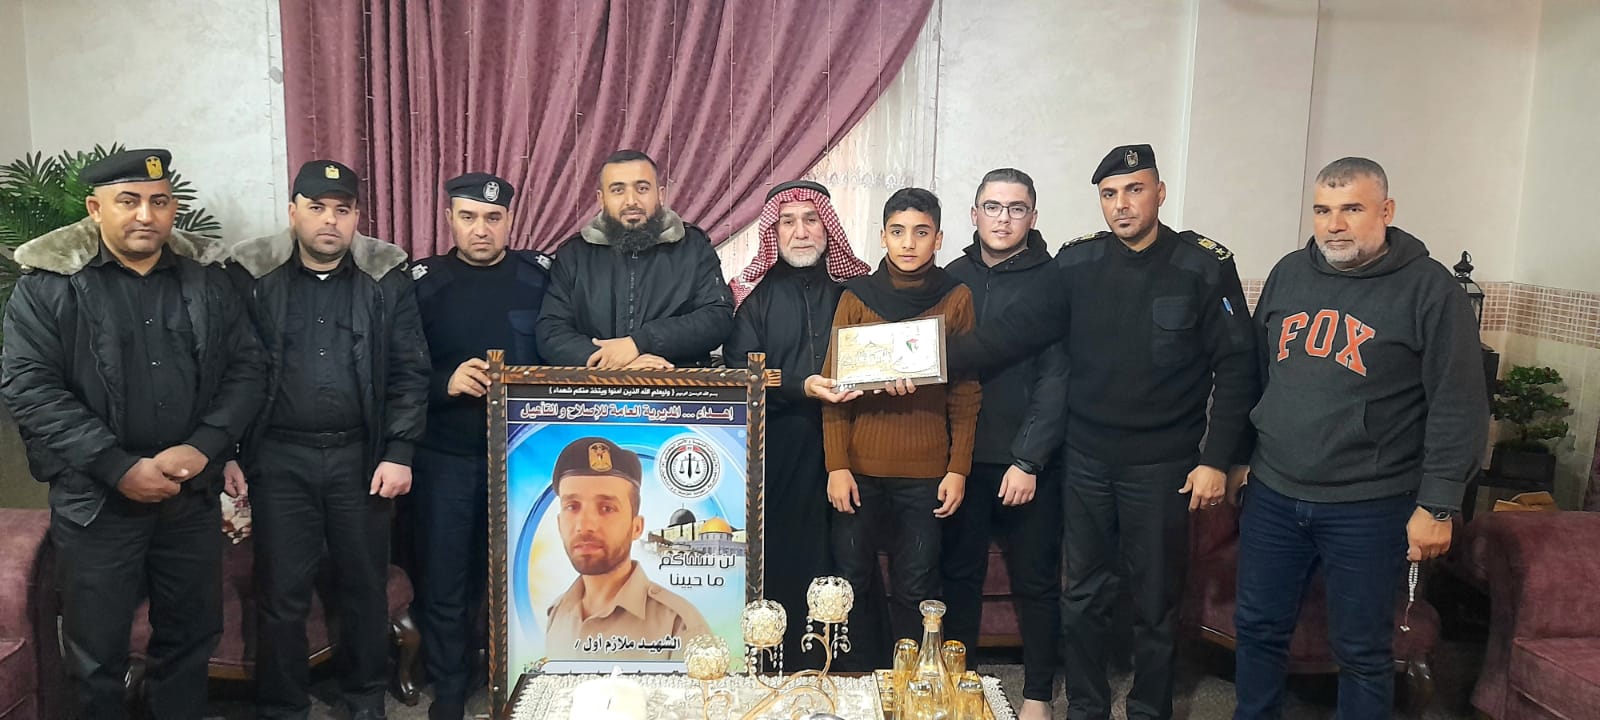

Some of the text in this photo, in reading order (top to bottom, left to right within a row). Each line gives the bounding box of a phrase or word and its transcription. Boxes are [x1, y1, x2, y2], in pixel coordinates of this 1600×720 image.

[1277, 308, 1377, 377] FOX
[553, 386, 572, 394] شهداء
[573, 387, 589, 396] منكم
[623, 387, 640, 397] الذين
[640, 387, 650, 395] الله
[520, 401, 559, 419] التأهيل
[567, 403, 609, 421] للإصلاح
[609, 403, 642, 418] العامة
[642, 404, 681, 422] المديرية
[658, 552, 736, 570] لن ننساكم
[669, 573, 725, 589] ما حيينا
[583, 632, 603, 651] أول
[604, 635, 635, 652] ملازم
[637, 634, 682, 653] الشهيد
